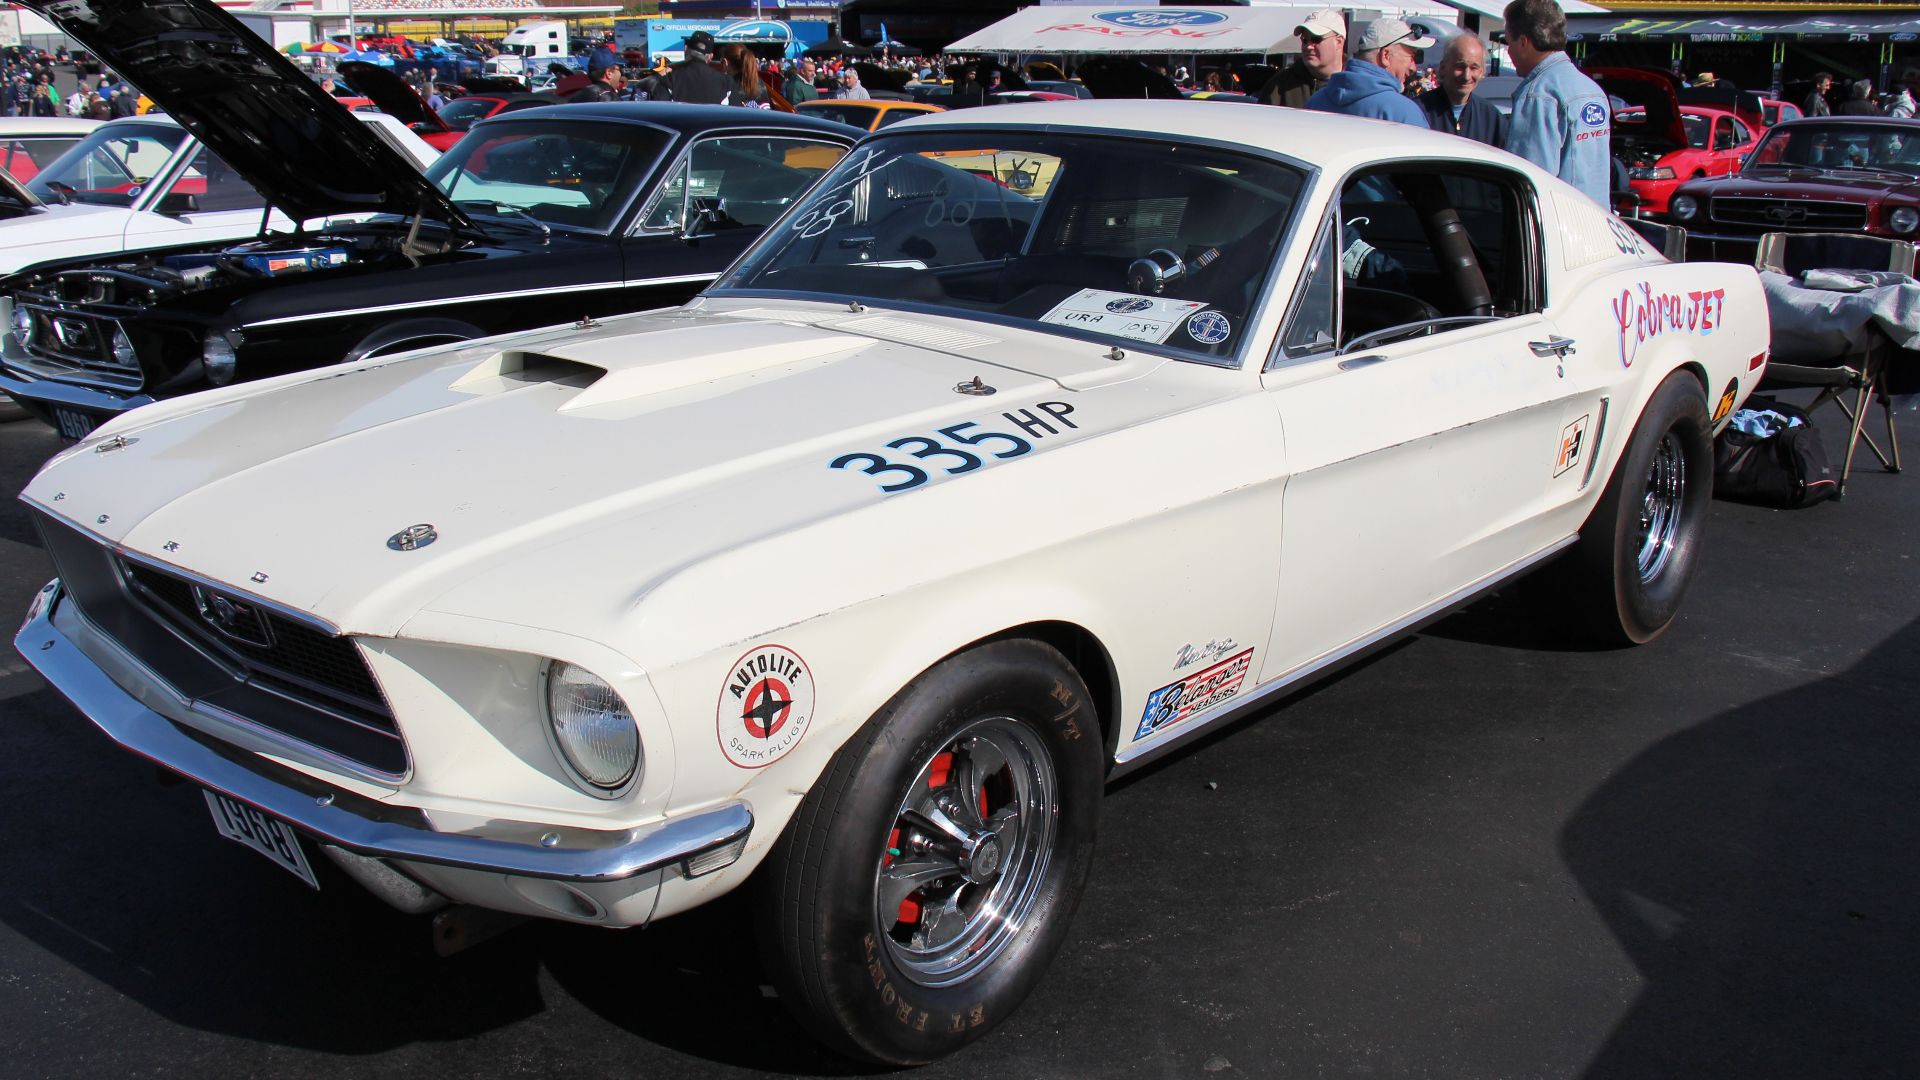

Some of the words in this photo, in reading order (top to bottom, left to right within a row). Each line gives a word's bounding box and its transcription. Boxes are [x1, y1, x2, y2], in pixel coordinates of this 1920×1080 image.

[1034, 23, 1243, 38] RACING
[1115, 11, 1202, 26] Ford
[1586, 105, 1604, 122] Ford
[1193, 313, 1221, 323] MUSTANG
[1612, 281, 1686, 368] Cobra
[1687, 288, 1725, 336] JET
[56, 408, 91, 440] 1968
[828, 421, 1035, 494] 335
[1002, 401, 1079, 439] HP
[729, 653, 803, 699] AUTOLITE
[1151, 657, 1244, 729] Belanger
[1190, 686, 1237, 714] HEADERS
[730, 737, 765, 760] SPARK
[769, 715, 805, 757] PLUGS
[215, 793, 298, 867] 1968
